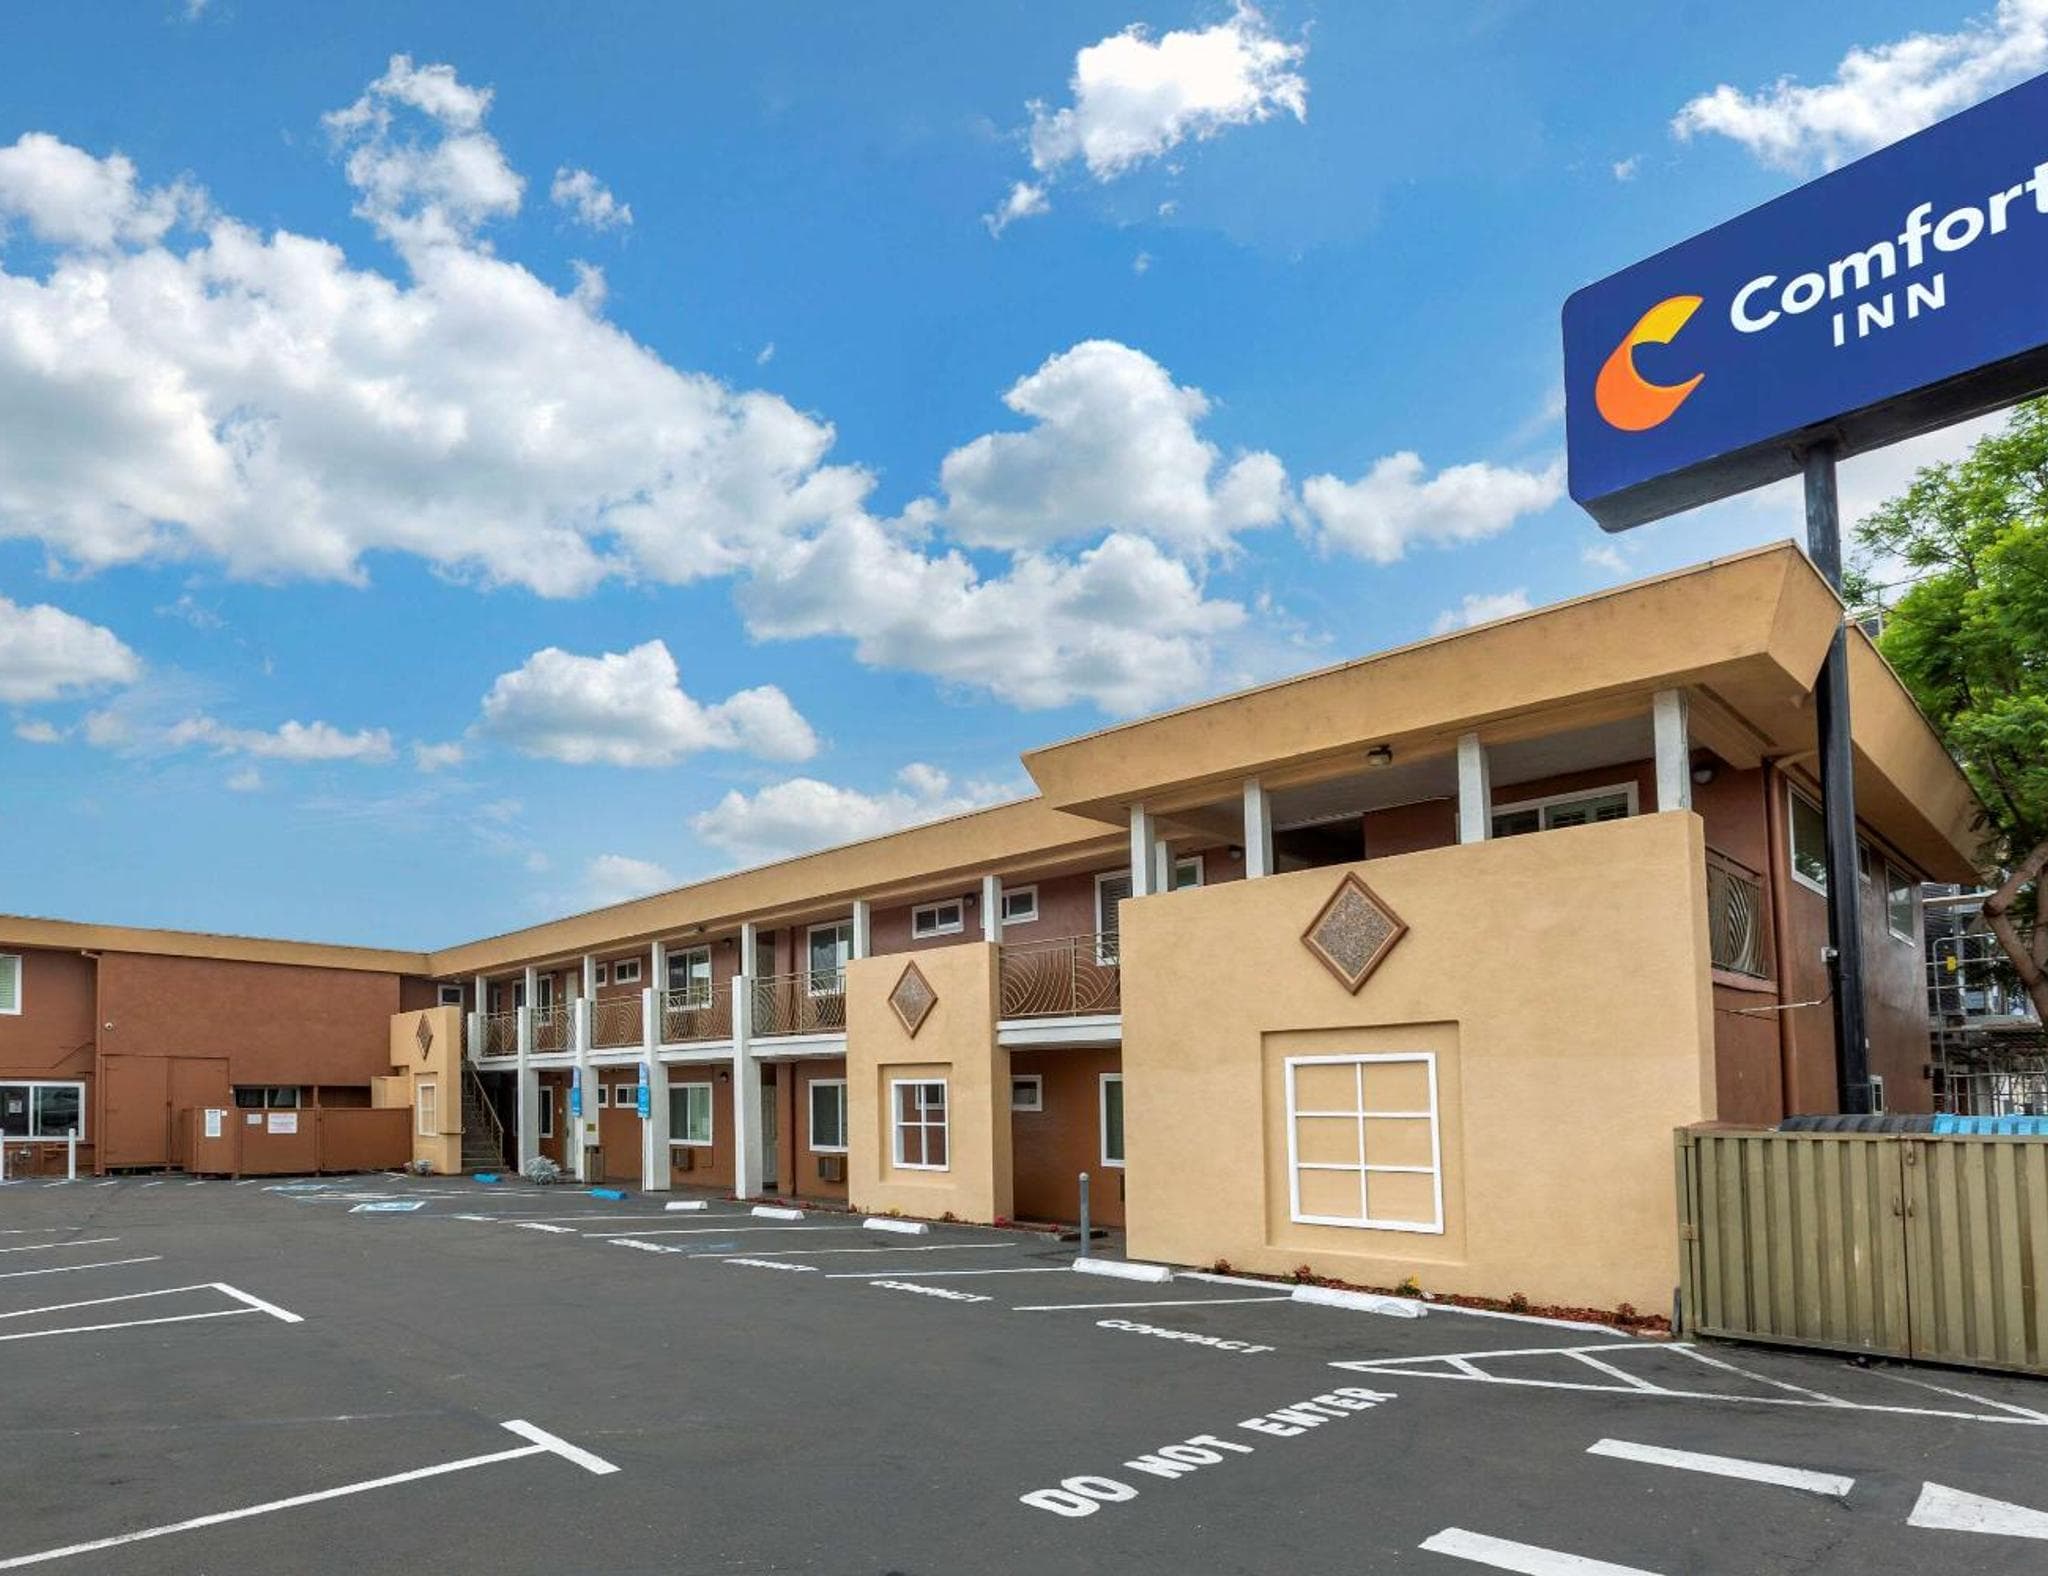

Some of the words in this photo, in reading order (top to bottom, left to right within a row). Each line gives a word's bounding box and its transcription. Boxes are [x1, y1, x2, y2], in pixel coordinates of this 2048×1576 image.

[1730, 162, 2048, 333] Comfort
[1833, 273, 1946, 346] INN
[1096, 1319, 1276, 1353] COMPACT
[1019, 1475, 1140, 1518] DO
[1123, 1434, 1255, 1479] NOT
[1237, 1387, 1398, 1437] ENTER
